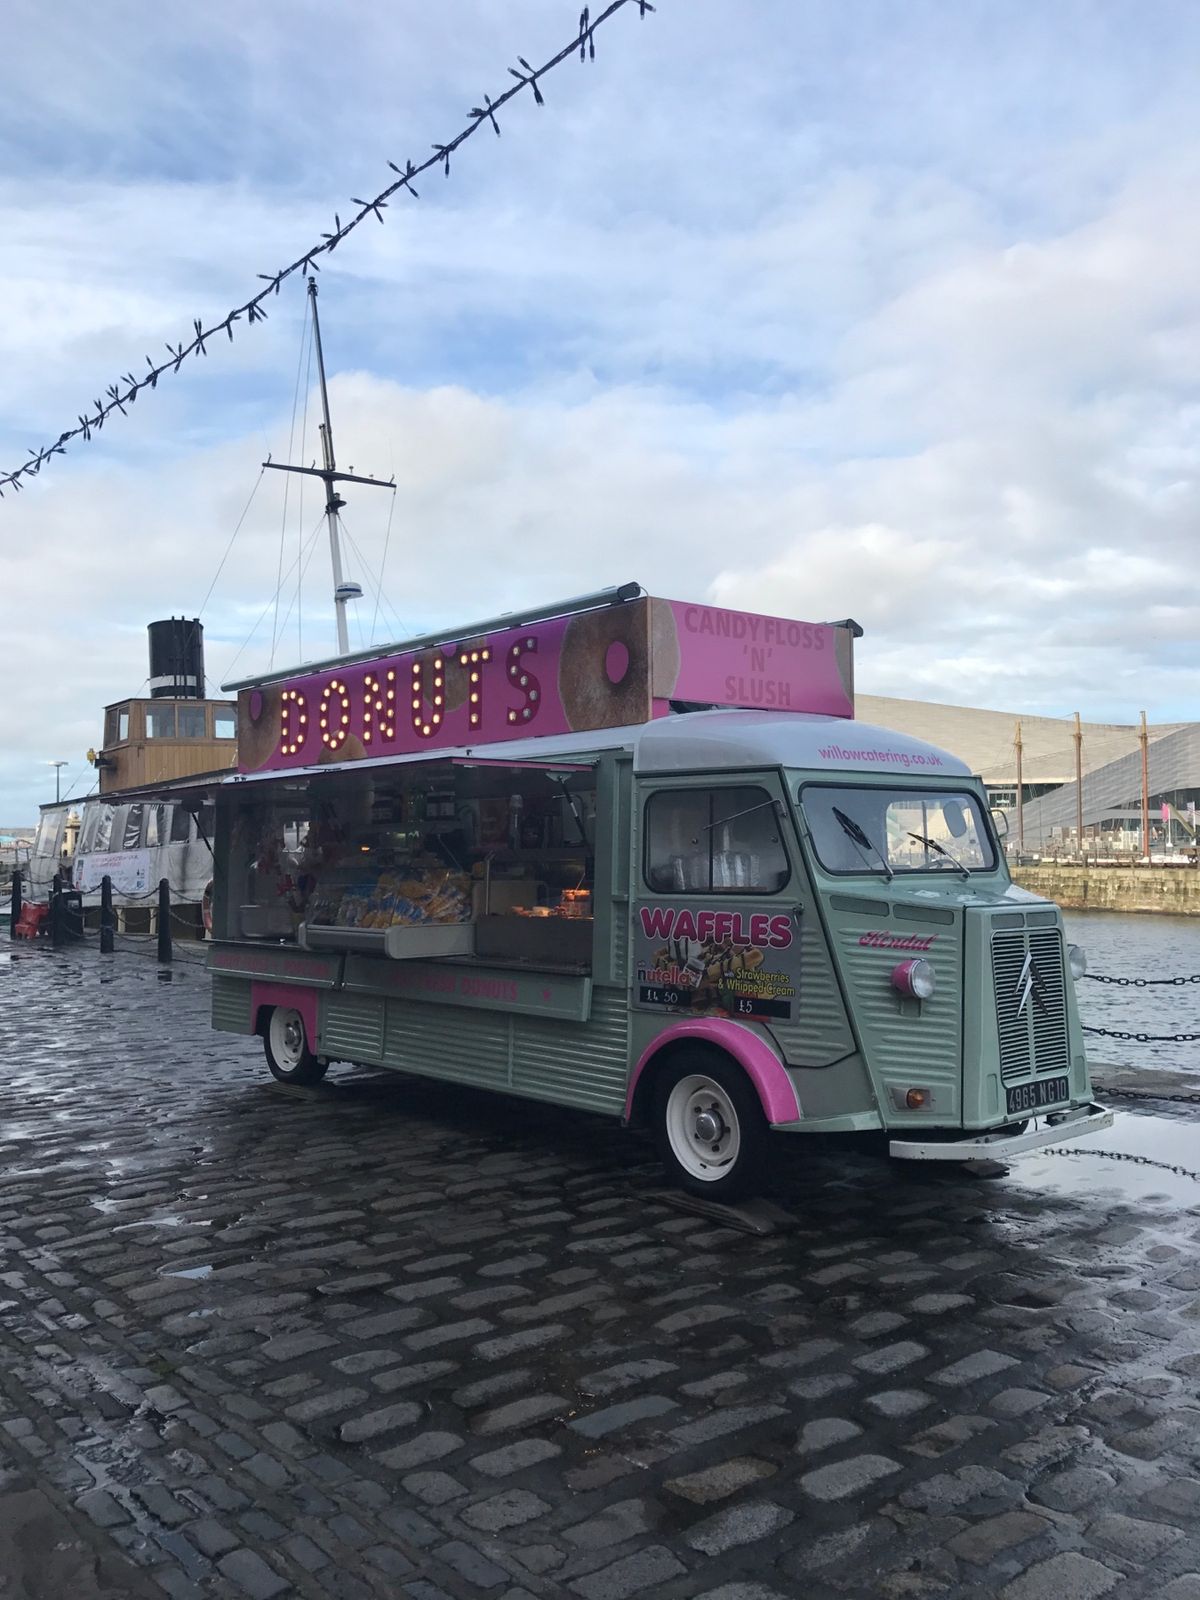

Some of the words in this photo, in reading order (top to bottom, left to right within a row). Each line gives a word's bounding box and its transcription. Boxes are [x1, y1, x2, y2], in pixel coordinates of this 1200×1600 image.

[281, 636, 542, 757] DONUTS
[725, 676, 791, 706] SLUSH
[819, 745, 943, 767] willowcatering.co.uk
[640, 907, 793, 949] WAFFLES
[638, 966, 689, 985] nutella
[736, 967, 790, 983] Strawberries
[718, 978, 724, 989] &
[727, 978, 764, 995] Whipped
[766, 983, 795, 996] Cream
[739, 1000, 753, 1013] £5
[1009, 1085, 1036, 1112] 4965
